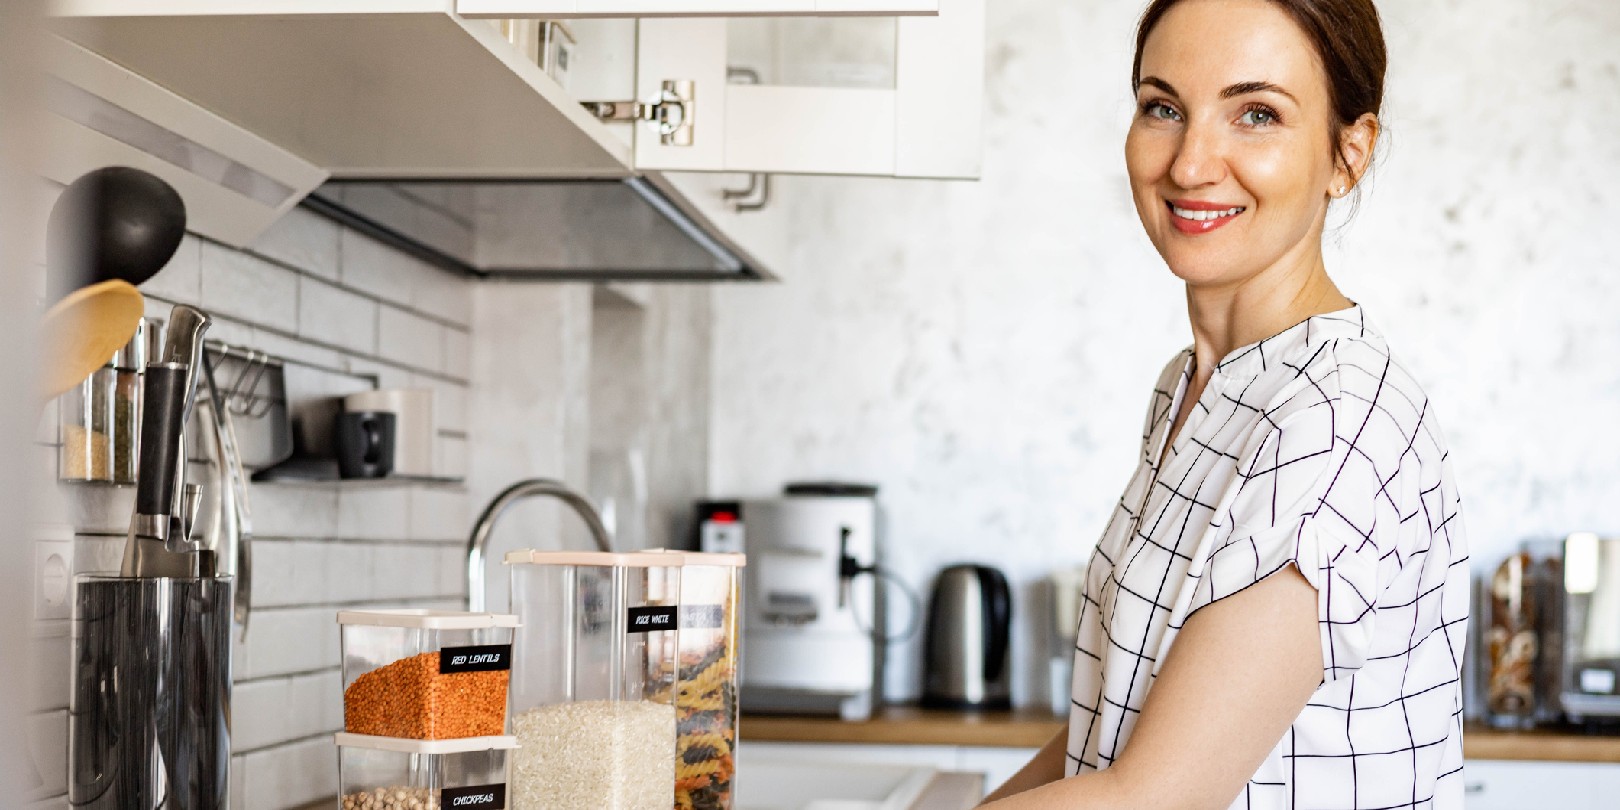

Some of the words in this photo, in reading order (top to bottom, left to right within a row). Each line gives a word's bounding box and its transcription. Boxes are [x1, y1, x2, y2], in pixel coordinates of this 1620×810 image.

[636, 614, 650, 624] RICE
[651, 614, 669, 624] WHITE
[451, 655, 467, 665] RED
[468, 653, 500, 664] LENTILS
[453, 793, 494, 806] CHICKPEAS
